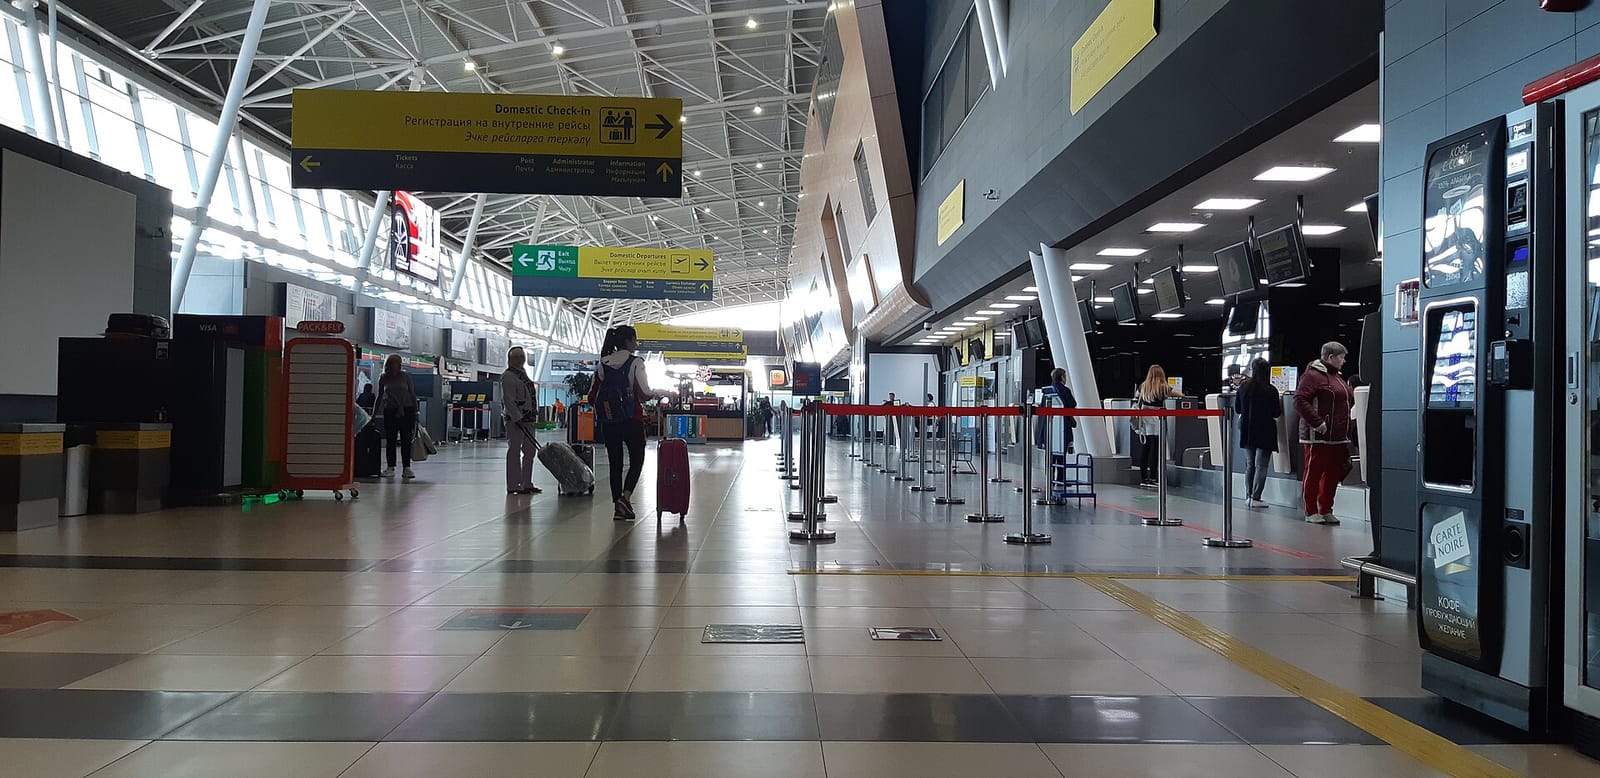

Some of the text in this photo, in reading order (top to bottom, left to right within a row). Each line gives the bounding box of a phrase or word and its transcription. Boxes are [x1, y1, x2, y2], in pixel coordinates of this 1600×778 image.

[495, 104, 591, 115] Domestic Check-in
[405, 116, 590, 131] Регистрация на внутренние рейсы
[465, 132, 591, 146] Эчке рейсларга теркәлү
[552, 158, 595, 166] Administrator
[610, 159, 646, 167] Information
[199, 323, 217, 331] VISA
[1435, 522, 1462, 545] CARTE
[1438, 536, 1465, 557] NOIRE
[1438, 596, 1460, 613] КОФЕ
[1438, 623, 1466, 639] ЖЕЛАНИЕ
